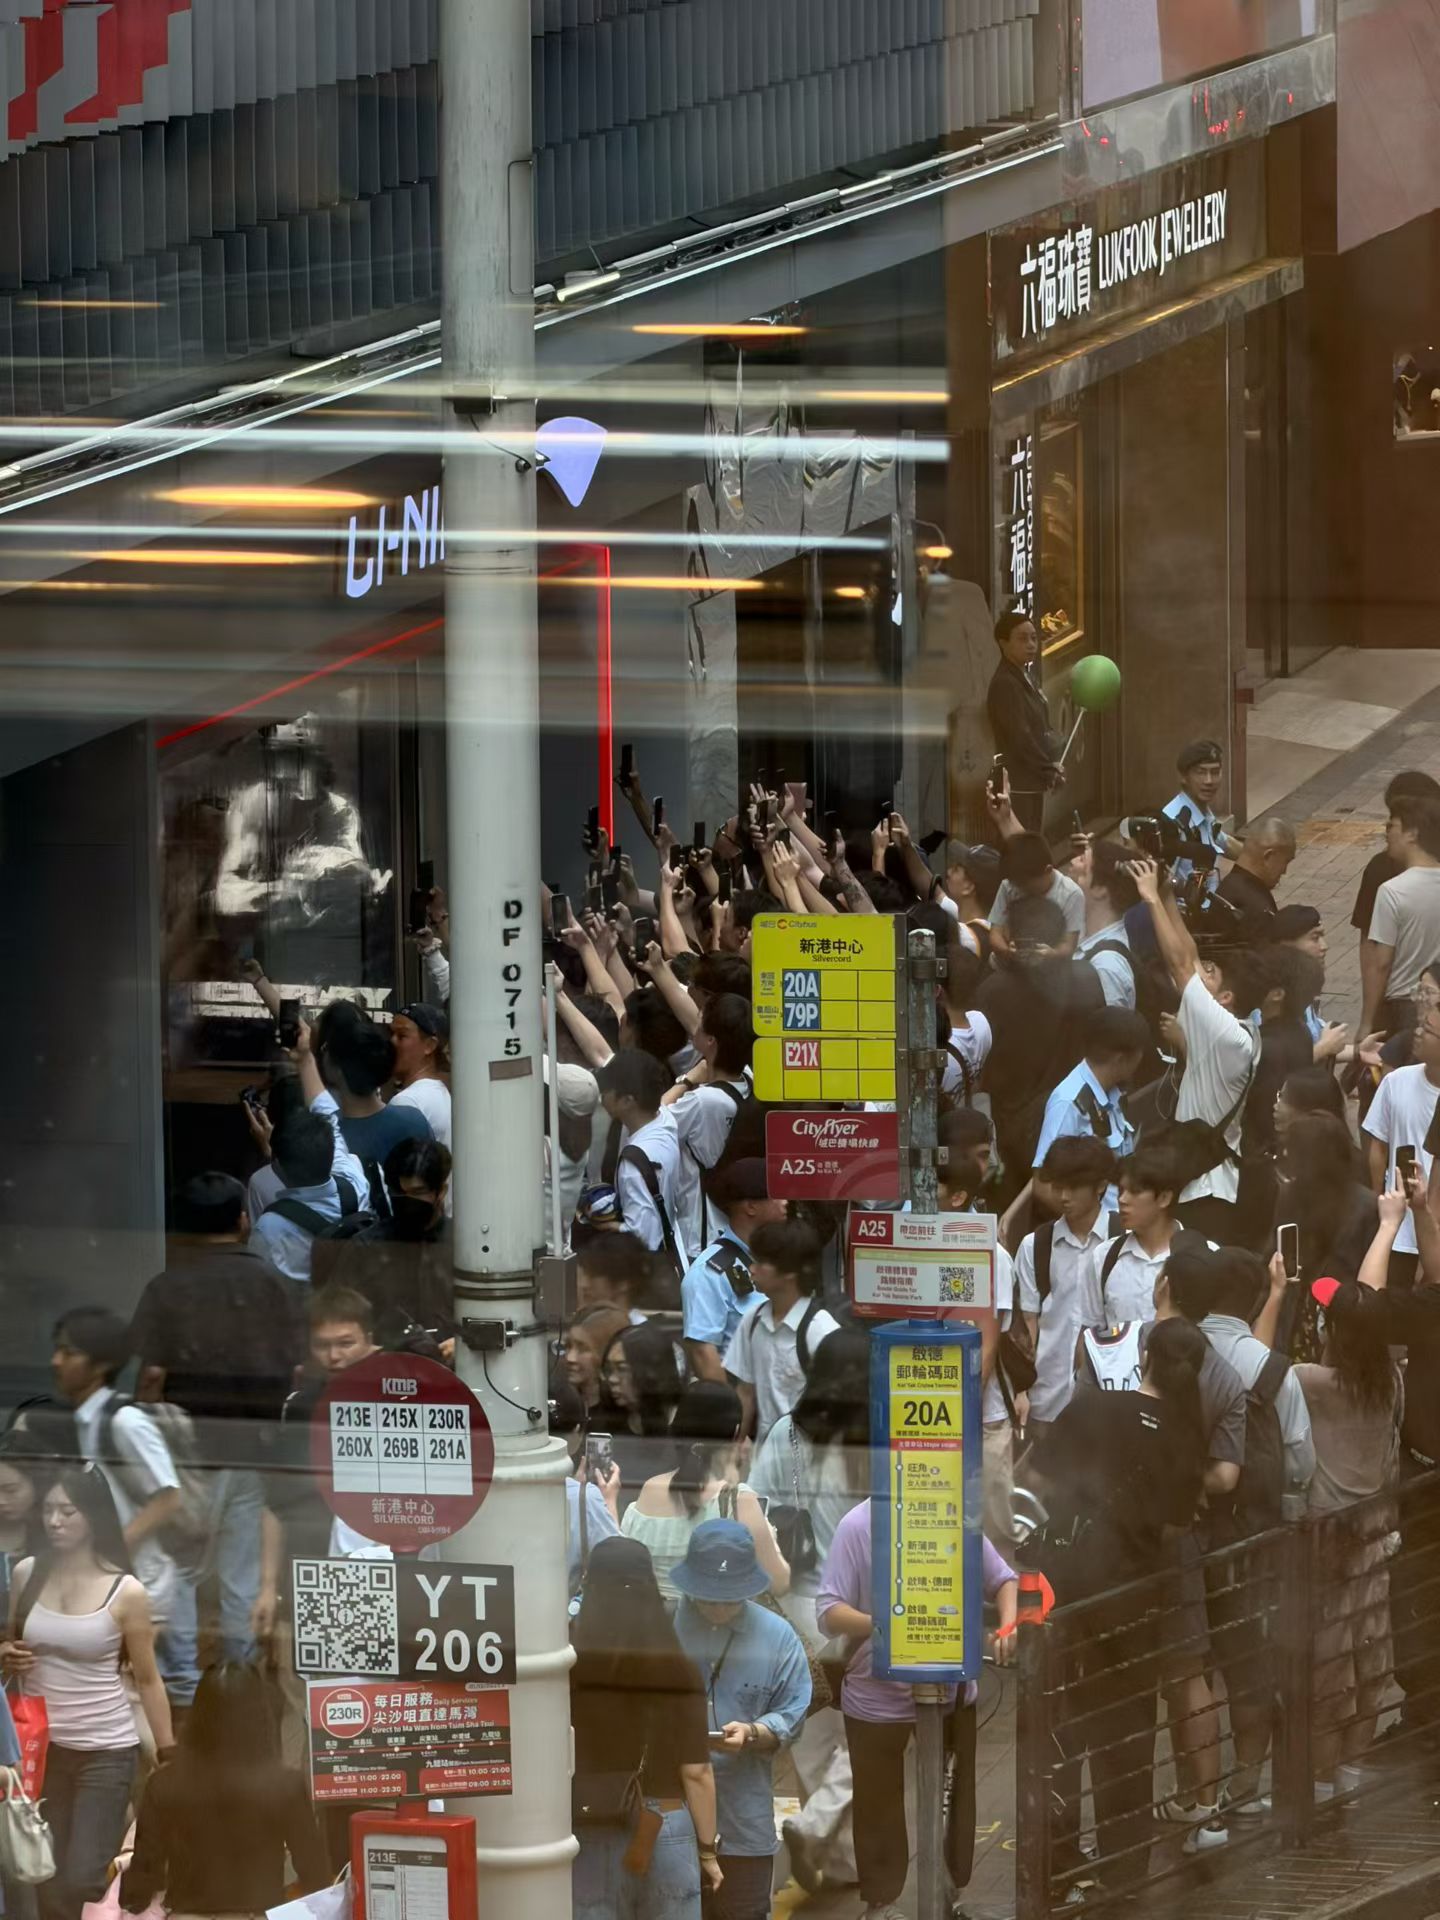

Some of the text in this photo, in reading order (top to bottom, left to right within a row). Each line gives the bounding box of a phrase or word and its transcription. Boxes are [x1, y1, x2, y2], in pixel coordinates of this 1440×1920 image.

[1098, 188, 1228, 289] LUKFOOK JEWELLERY
[1020, 223, 1093, 339] 六福珠寶
[346, 485, 445, 598] LI-NI
[800, 938, 864, 954] 新港中心
[502, 900, 523, 1056] DF 0715
[784, 972, 819, 998] 20A
[784, 1003, 819, 1027] 79P
[785, 1042, 818, 1067] E21X
[780, 1159, 816, 1175] A25
[858, 1220, 887, 1237] A25
[896, 1365, 959, 1380] 郵輪碼頭
[382, 1378, 418, 1395] KMB
[336, 1407, 465, 1429] 213E 215X 230R
[903, 1400, 952, 1426] 20A
[337, 1436, 466, 1460] 260X 269B 281A
[907, 1463, 928, 1473] 旺角
[371, 1498, 435, 1515] 新港中心
[374, 1515, 434, 1525] SILVERCORD
[415, 1574, 498, 1621] YT
[415, 1628, 503, 1675] 206
[374, 1692, 434, 1708] 每日服務
[434, 1697, 478, 1706] Daily Services
[328, 1707, 362, 1721] 230R
[373, 1706, 479, 1725] 尖沙咀直達馬灣
[372, 1726, 393, 1734] Direct
[414, 1724, 430, 1732] Wan
[430, 1723, 447, 1731] from
[369, 1852, 397, 1863] 213E
